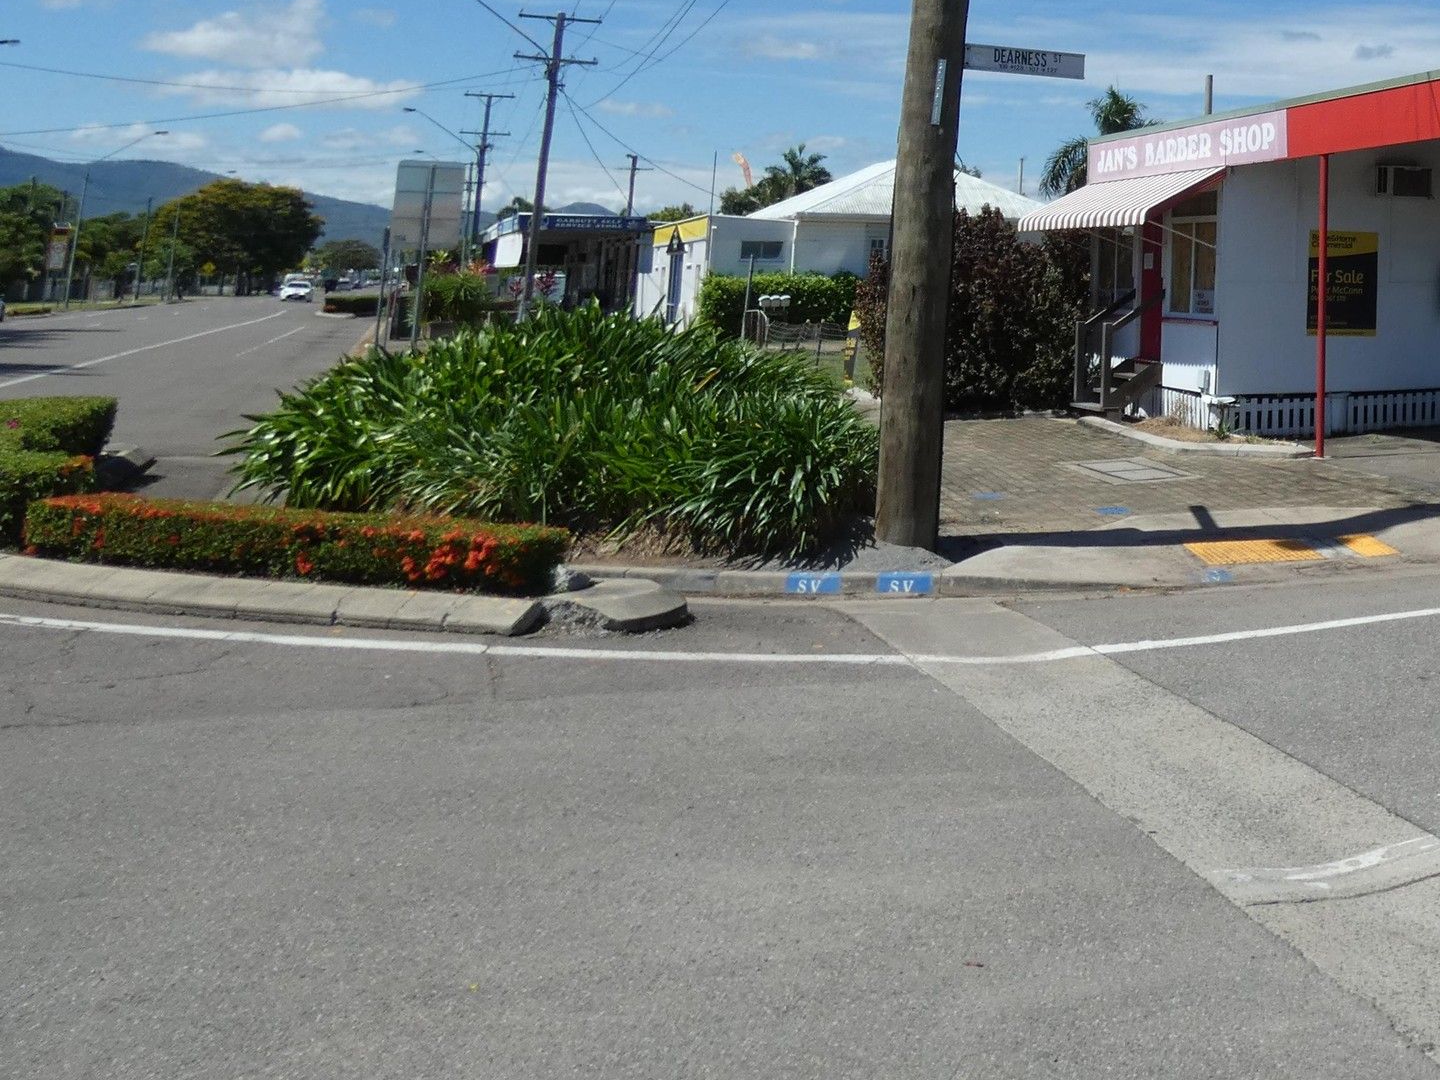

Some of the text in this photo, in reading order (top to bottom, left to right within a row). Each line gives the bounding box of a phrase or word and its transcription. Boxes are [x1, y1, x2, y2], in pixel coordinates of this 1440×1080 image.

[993, 48, 1062, 67] DEARNESS ST
[1097, 122, 1276, 173] JAN'S BARBER SHOP
[1311, 269, 1365, 284] Fr Sale
